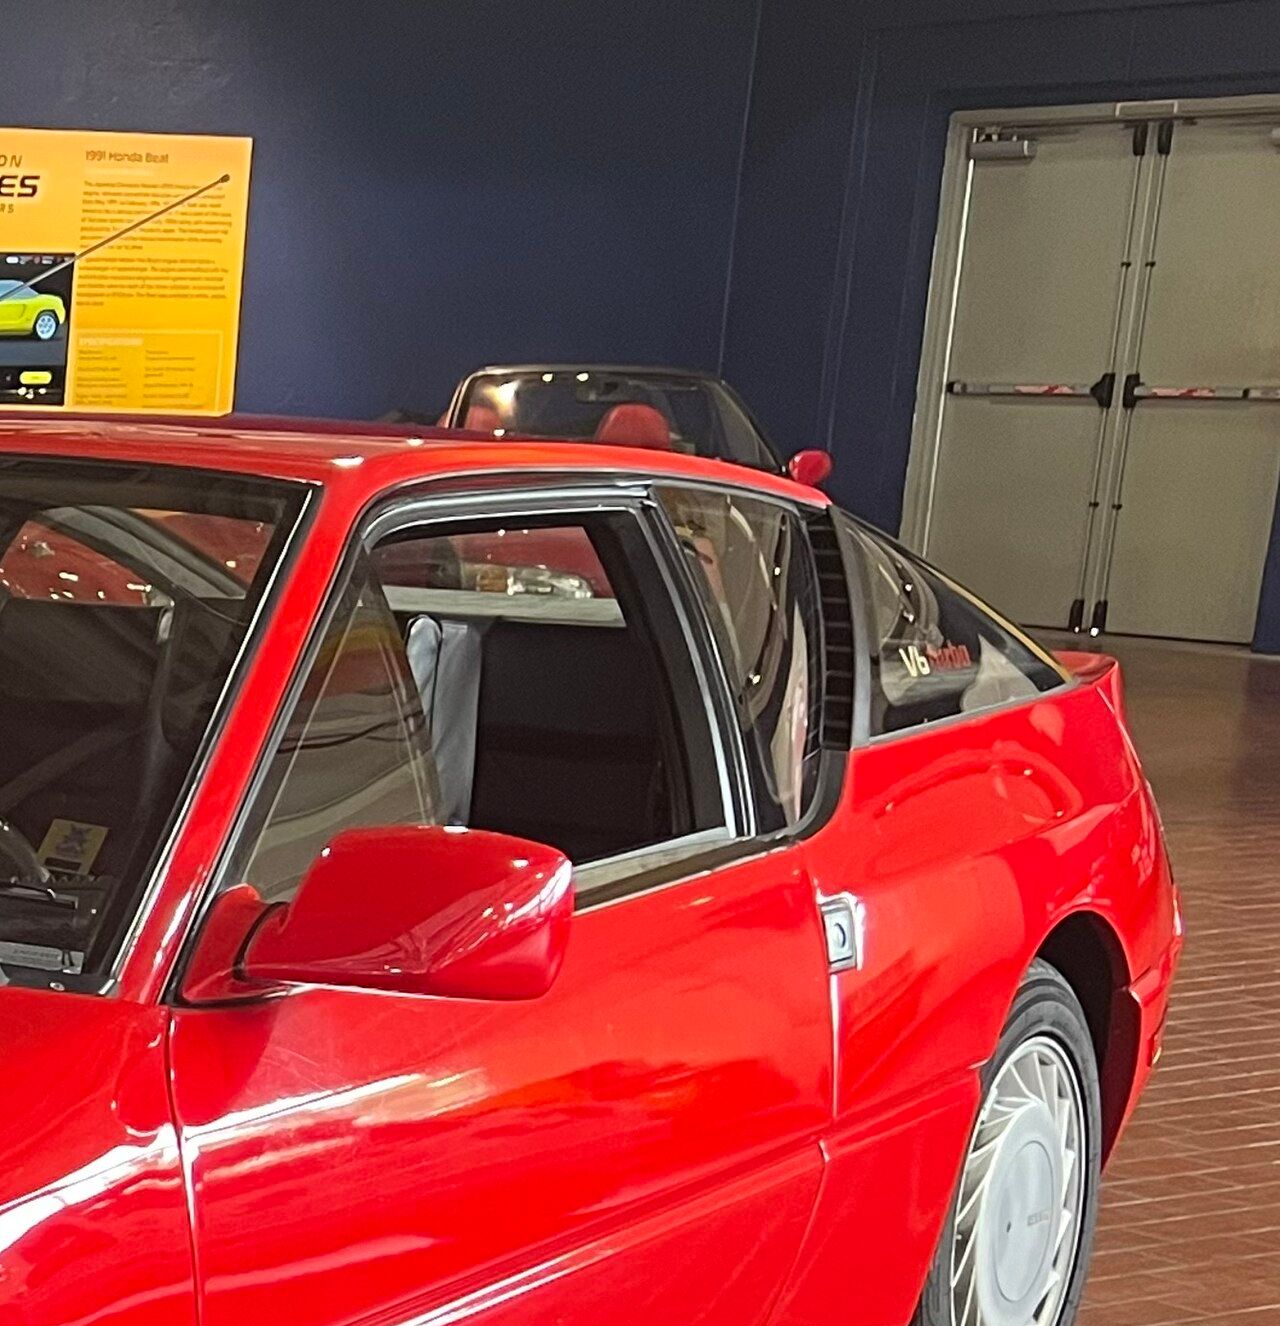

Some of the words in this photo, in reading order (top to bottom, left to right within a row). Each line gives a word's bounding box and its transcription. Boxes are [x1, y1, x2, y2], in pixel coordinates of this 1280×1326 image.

[108, 152, 143, 163] Honda
[145, 152, 169, 164] Beat
[898, 645, 931, 678] V6
